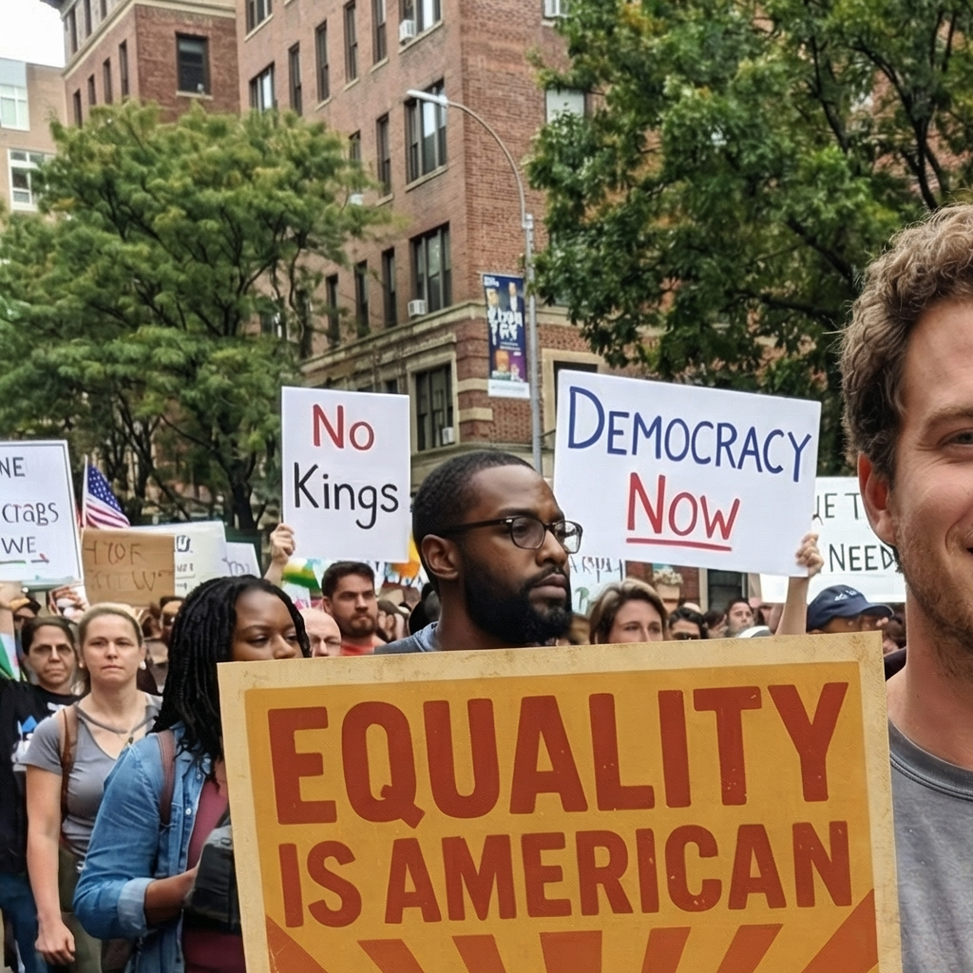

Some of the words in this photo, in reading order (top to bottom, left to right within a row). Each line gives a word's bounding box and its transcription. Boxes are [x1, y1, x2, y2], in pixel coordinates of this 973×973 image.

[312, 403, 375, 451] No
[567, 385, 812, 483] DEMOCRACY
[293, 462, 399, 530] Kings
[267, 681, 850, 830] EQUALITY
[278, 840, 362, 928] IS
[384, 820, 853, 924] AMERICAN
